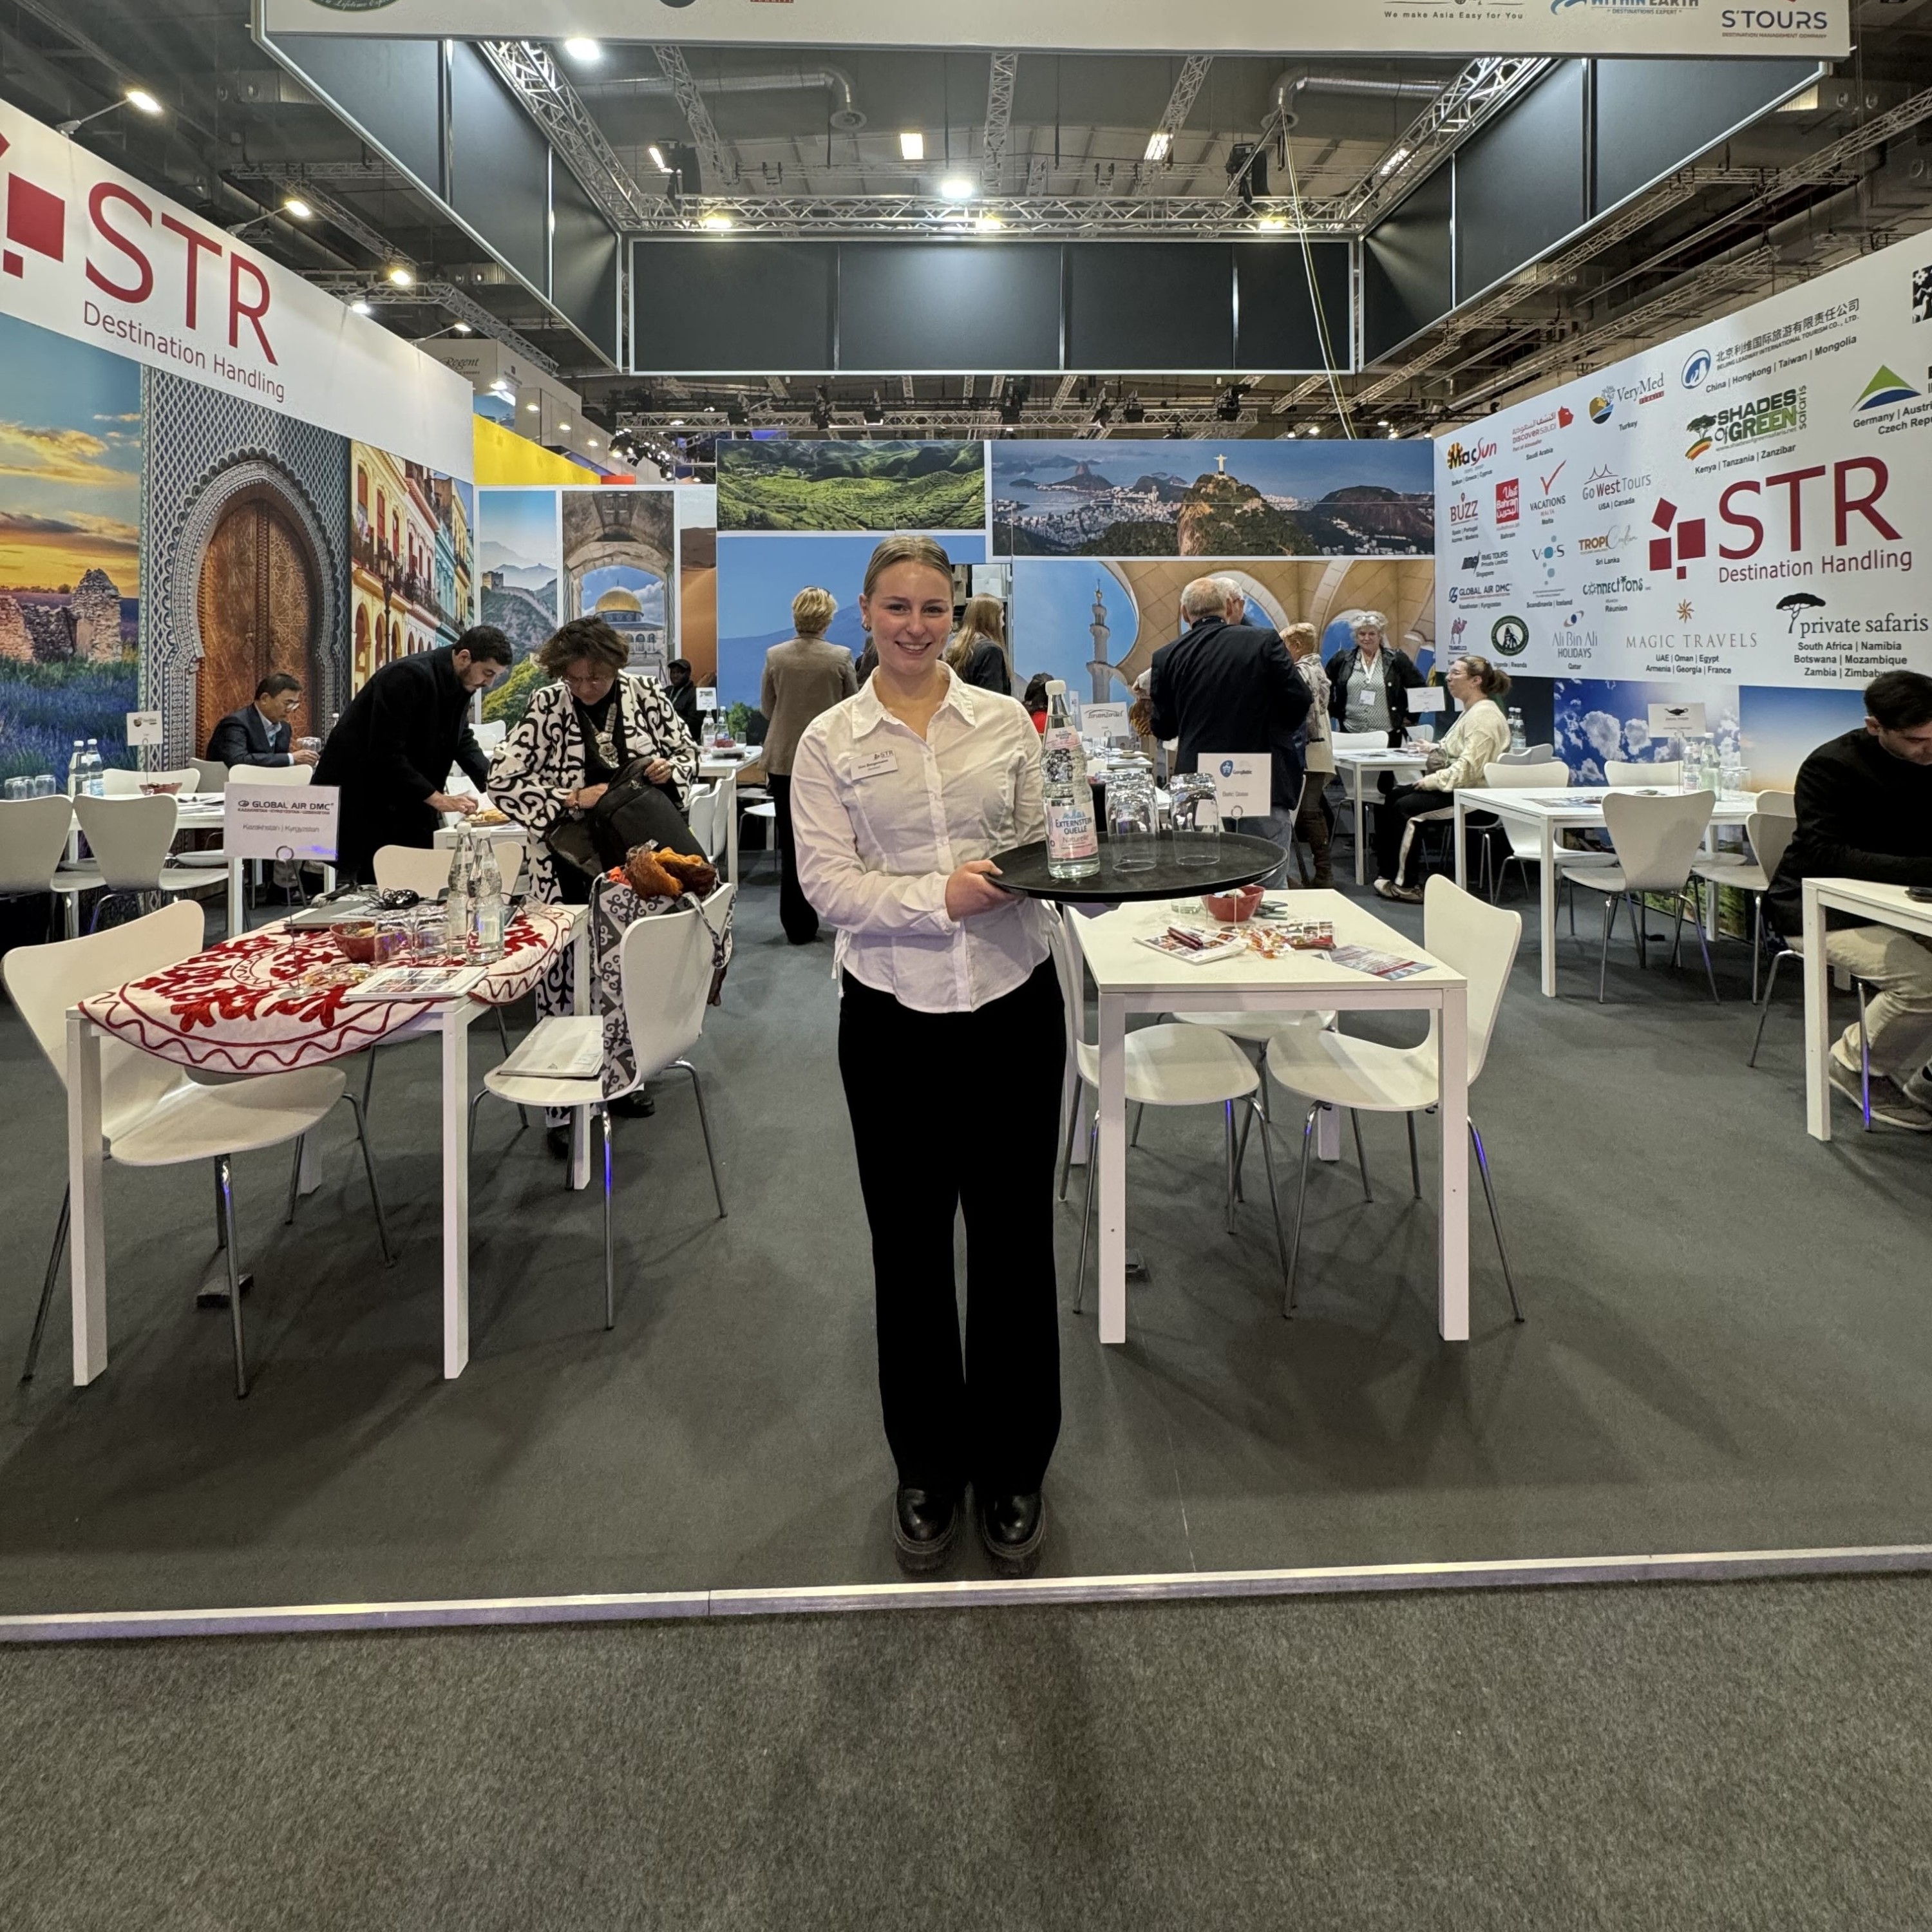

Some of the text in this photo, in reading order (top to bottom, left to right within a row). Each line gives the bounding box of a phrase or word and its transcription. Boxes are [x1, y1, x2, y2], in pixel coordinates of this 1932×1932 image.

[85, 182, 279, 366] STR
[84, 299, 285, 404] Destination Handling
[439, 356, 480, 371] Regent
[1705, 335, 1857, 393] China Hongkong Taiwan Mongolia
[1616, 372, 1665, 402] VeryMed
[1717, 388, 1797, 426] SHADES
[1797, 384, 1807, 430] safaris
[1853, 400, 1932, 429] Germany Austri
[1618, 421, 1638, 431] Turkey
[1728, 404, 1797, 442] GREEN
[1877, 419, 1908, 435] Czech
[1694, 444, 1797, 475] Kenya Tanzania Zanzibar
[1582, 475, 1652, 500] Go West Tours
[1450, 500, 1479, 522] BUZZ
[1530, 495, 1566, 511] VACATIONS
[1598, 497, 1635, 511] USA Canada
[1719, 456, 1904, 560] STR
[1719, 549, 1912, 583] Destination Handling
[1459, 586, 1481, 596] GLOBAL
[1483, 585, 1493, 594] AIR
[1800, 612, 1929, 639] private safaris
[1566, 631, 1582, 647] Bin
[1625, 632, 1757, 649] MAGIC TRAVELS
[1797, 641, 1902, 651] South Africa Namibia
[1557, 648, 1592, 658] HOLIDAYS
[1655, 654, 1719, 664] UAE Oman Egypt
[1794, 654, 1908, 667] Botswana Mozambique
[1645, 665, 1732, 675] Armenia Georgia France
[1804, 667, 1887, 677] Zambia Zimbab
[252, 800, 289, 809] GLOBAL
[1063, 825, 1088, 835] QUELLE
